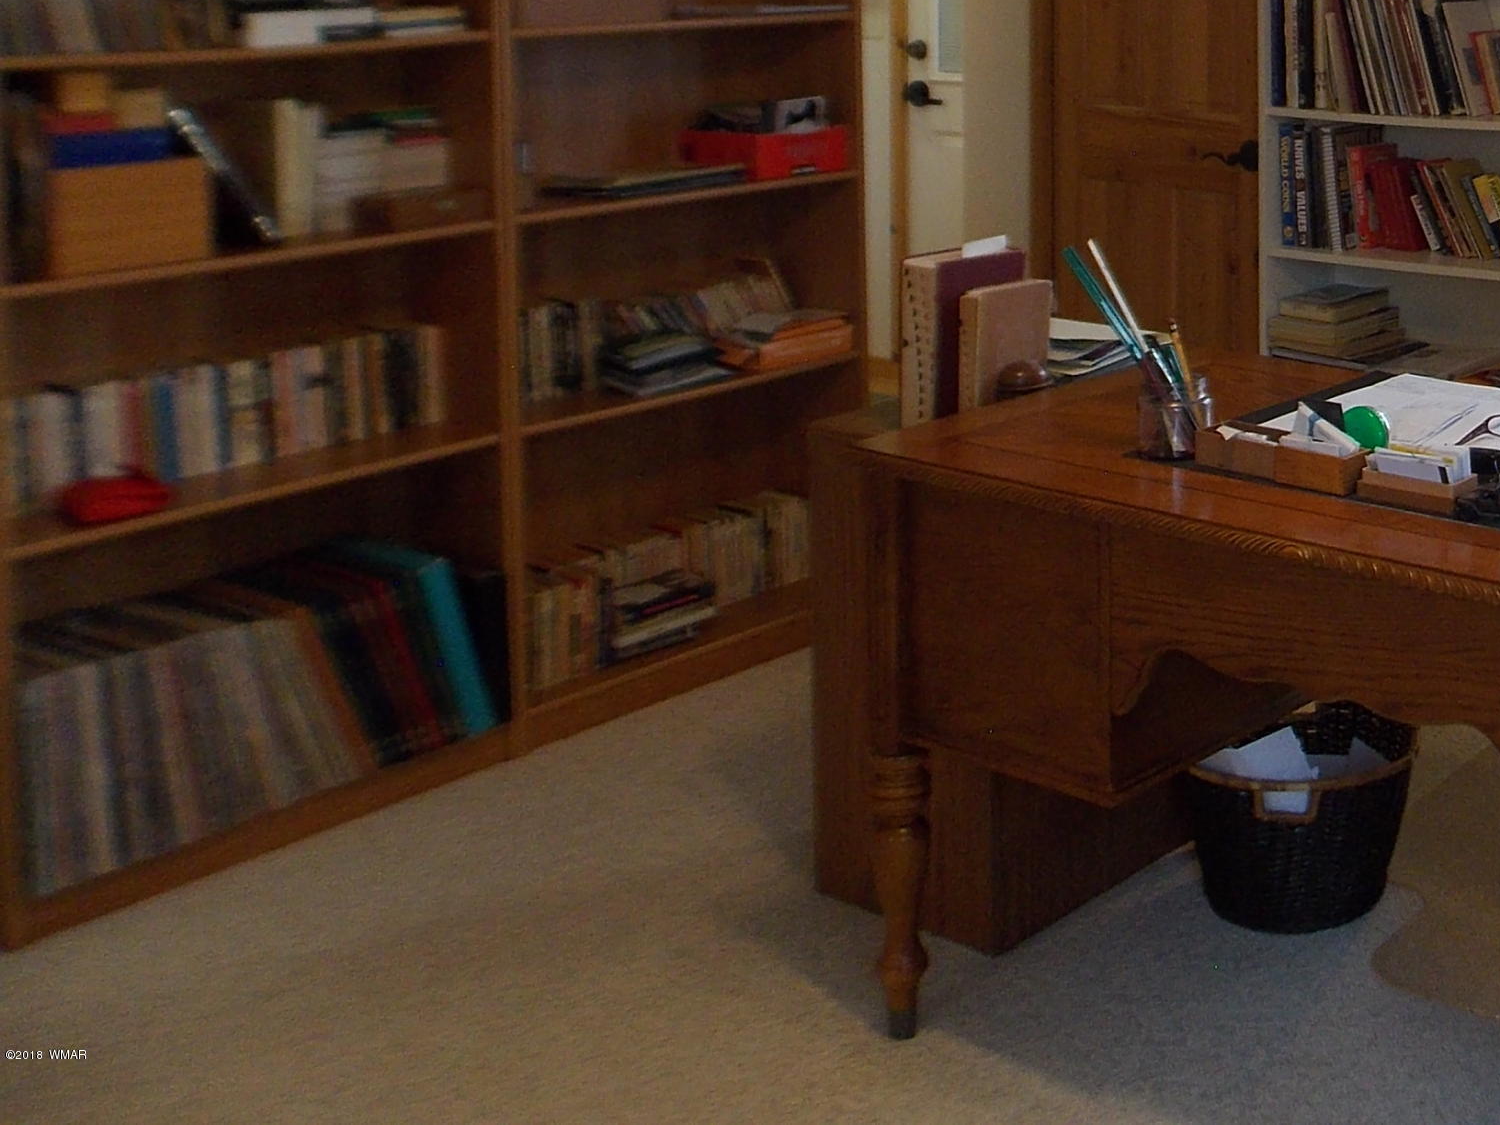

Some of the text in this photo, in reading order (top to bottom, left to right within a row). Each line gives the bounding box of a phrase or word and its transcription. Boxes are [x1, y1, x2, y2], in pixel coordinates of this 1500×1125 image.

[1281, 135, 1290, 177] WORLD
[1294, 139, 1305, 180] KNIVES
[1296, 191, 1307, 233] VALUES
